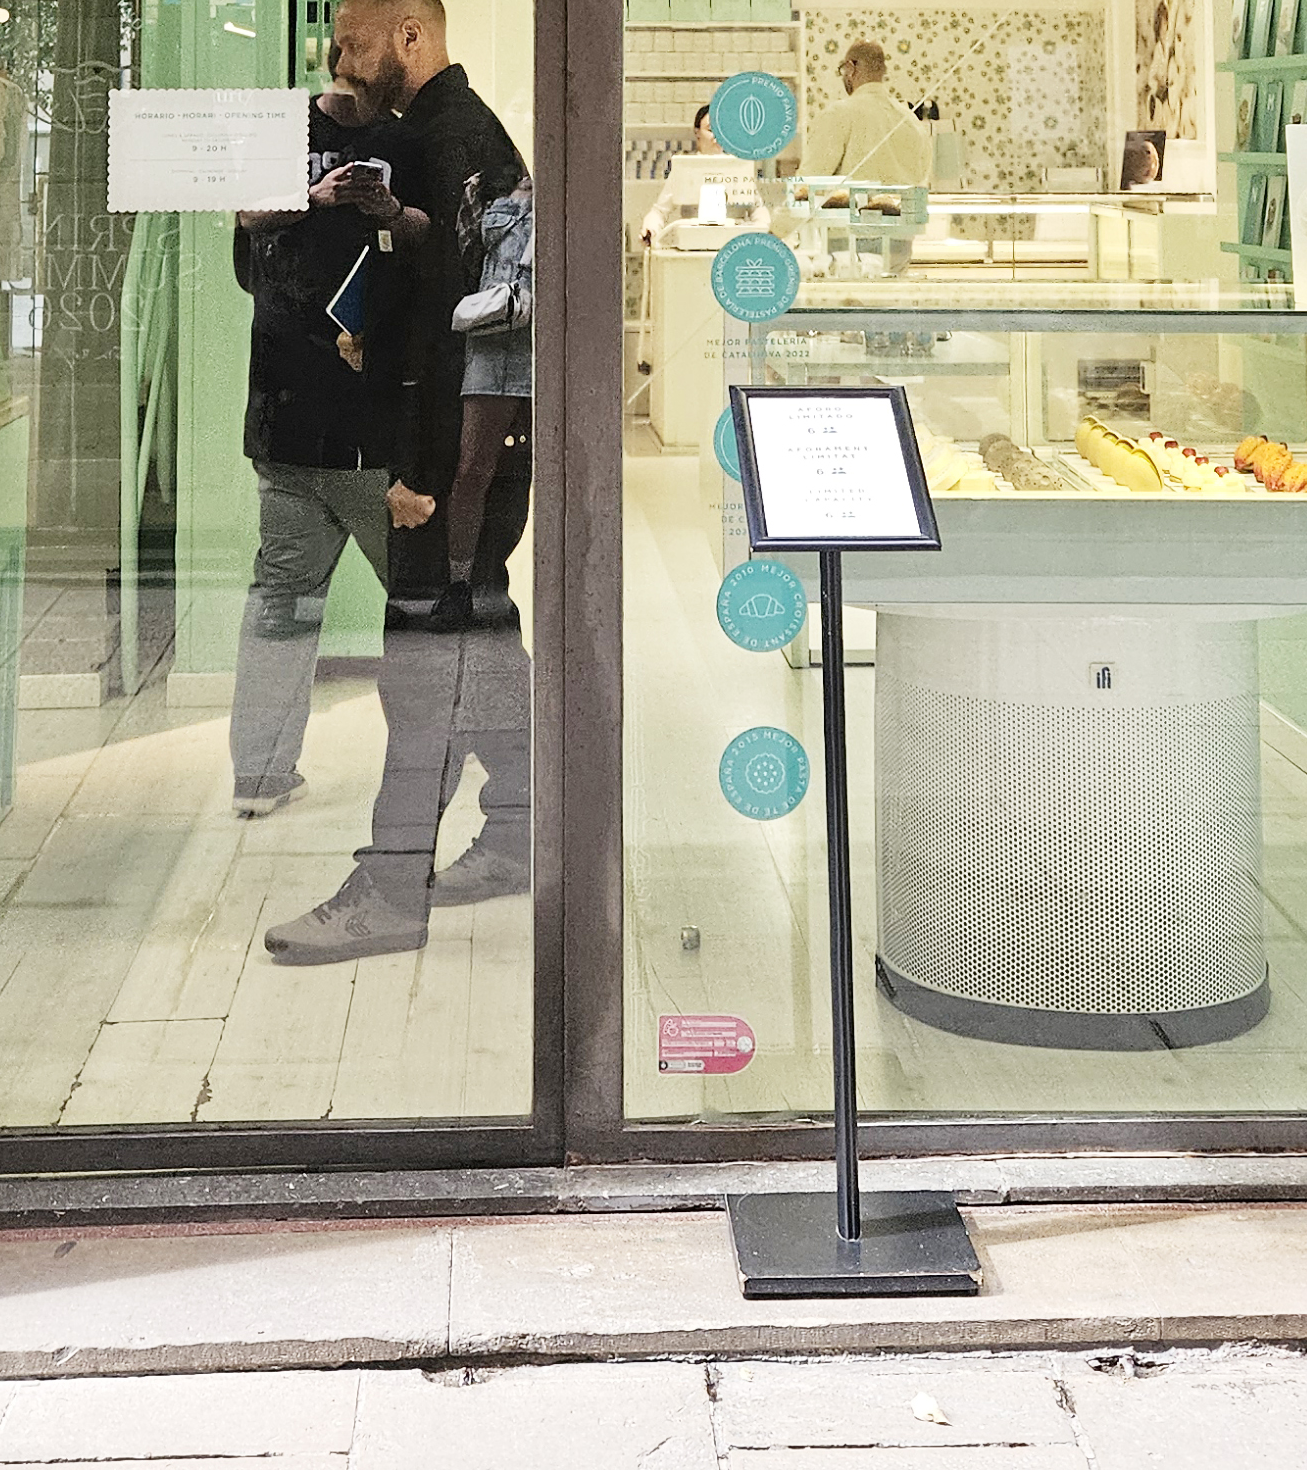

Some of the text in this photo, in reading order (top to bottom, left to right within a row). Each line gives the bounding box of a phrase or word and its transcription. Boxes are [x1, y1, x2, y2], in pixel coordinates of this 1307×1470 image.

[751, 76, 785, 98] PREMIO
[134, 112, 175, 120] HORARIO
[781, 98, 793, 123] FAVA
[781, 124, 792, 136] DE
[704, 176, 739, 184] MEJOR
[754, 236, 786, 259] PREMIO
[715, 237, 753, 283] BARCELONA
[784, 257, 796, 295] GREMIO
[715, 285, 728, 298] DE
[776, 295, 790, 309] DE
[706, 338, 741, 346] MEJOR
[786, 350, 810, 358] 2022
[722, 515, 735, 523] DE
[721, 564, 802, 648] MEJOR CROISSANT DE ESPAÑA 2010
[763, 731, 799, 753] MEJOR
[795, 756, 807, 793] PASTA
[744, 802, 760, 815] DE
[781, 795, 796, 809] DE
